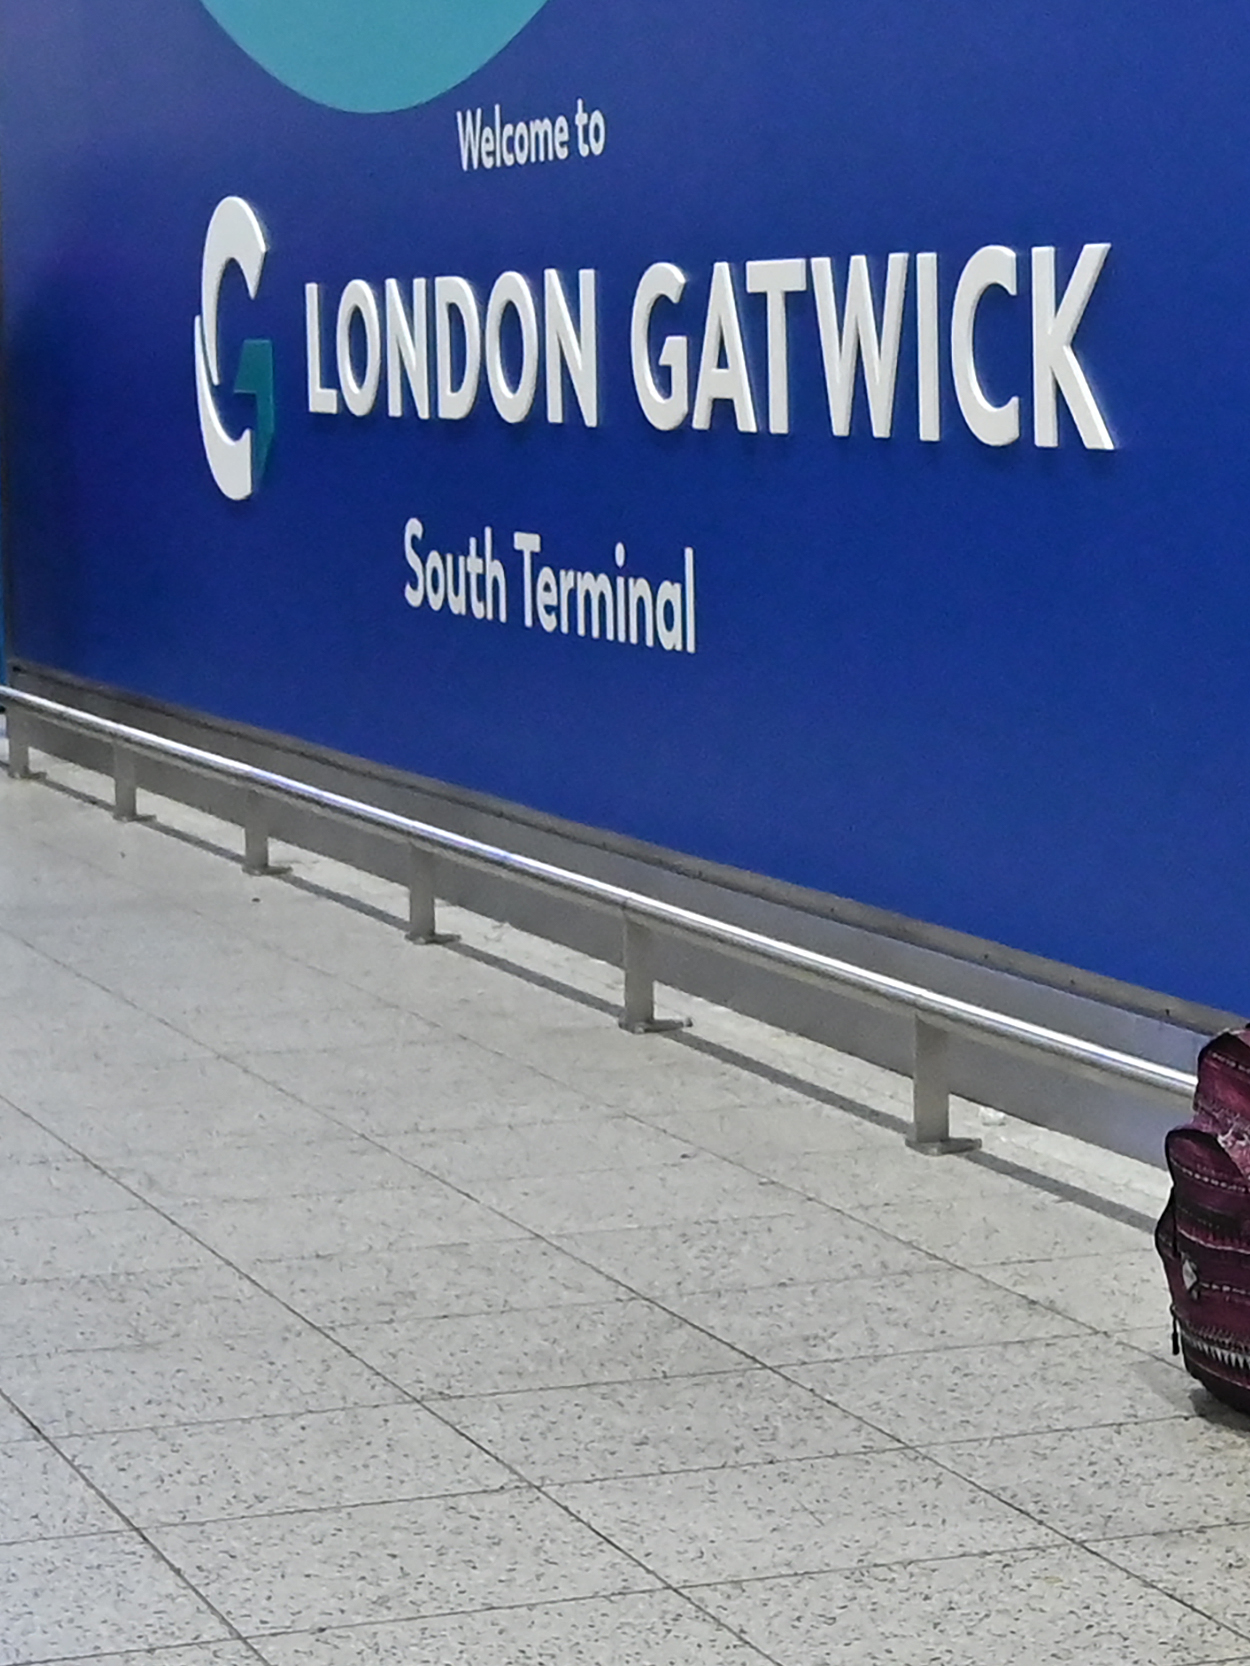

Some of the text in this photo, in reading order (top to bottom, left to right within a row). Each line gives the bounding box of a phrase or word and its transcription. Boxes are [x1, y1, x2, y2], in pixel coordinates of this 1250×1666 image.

[456, 98, 607, 171] Welcome to
[304, 242, 1116, 452] LONDON GATWICK
[403, 517, 697, 654] South Terminal
